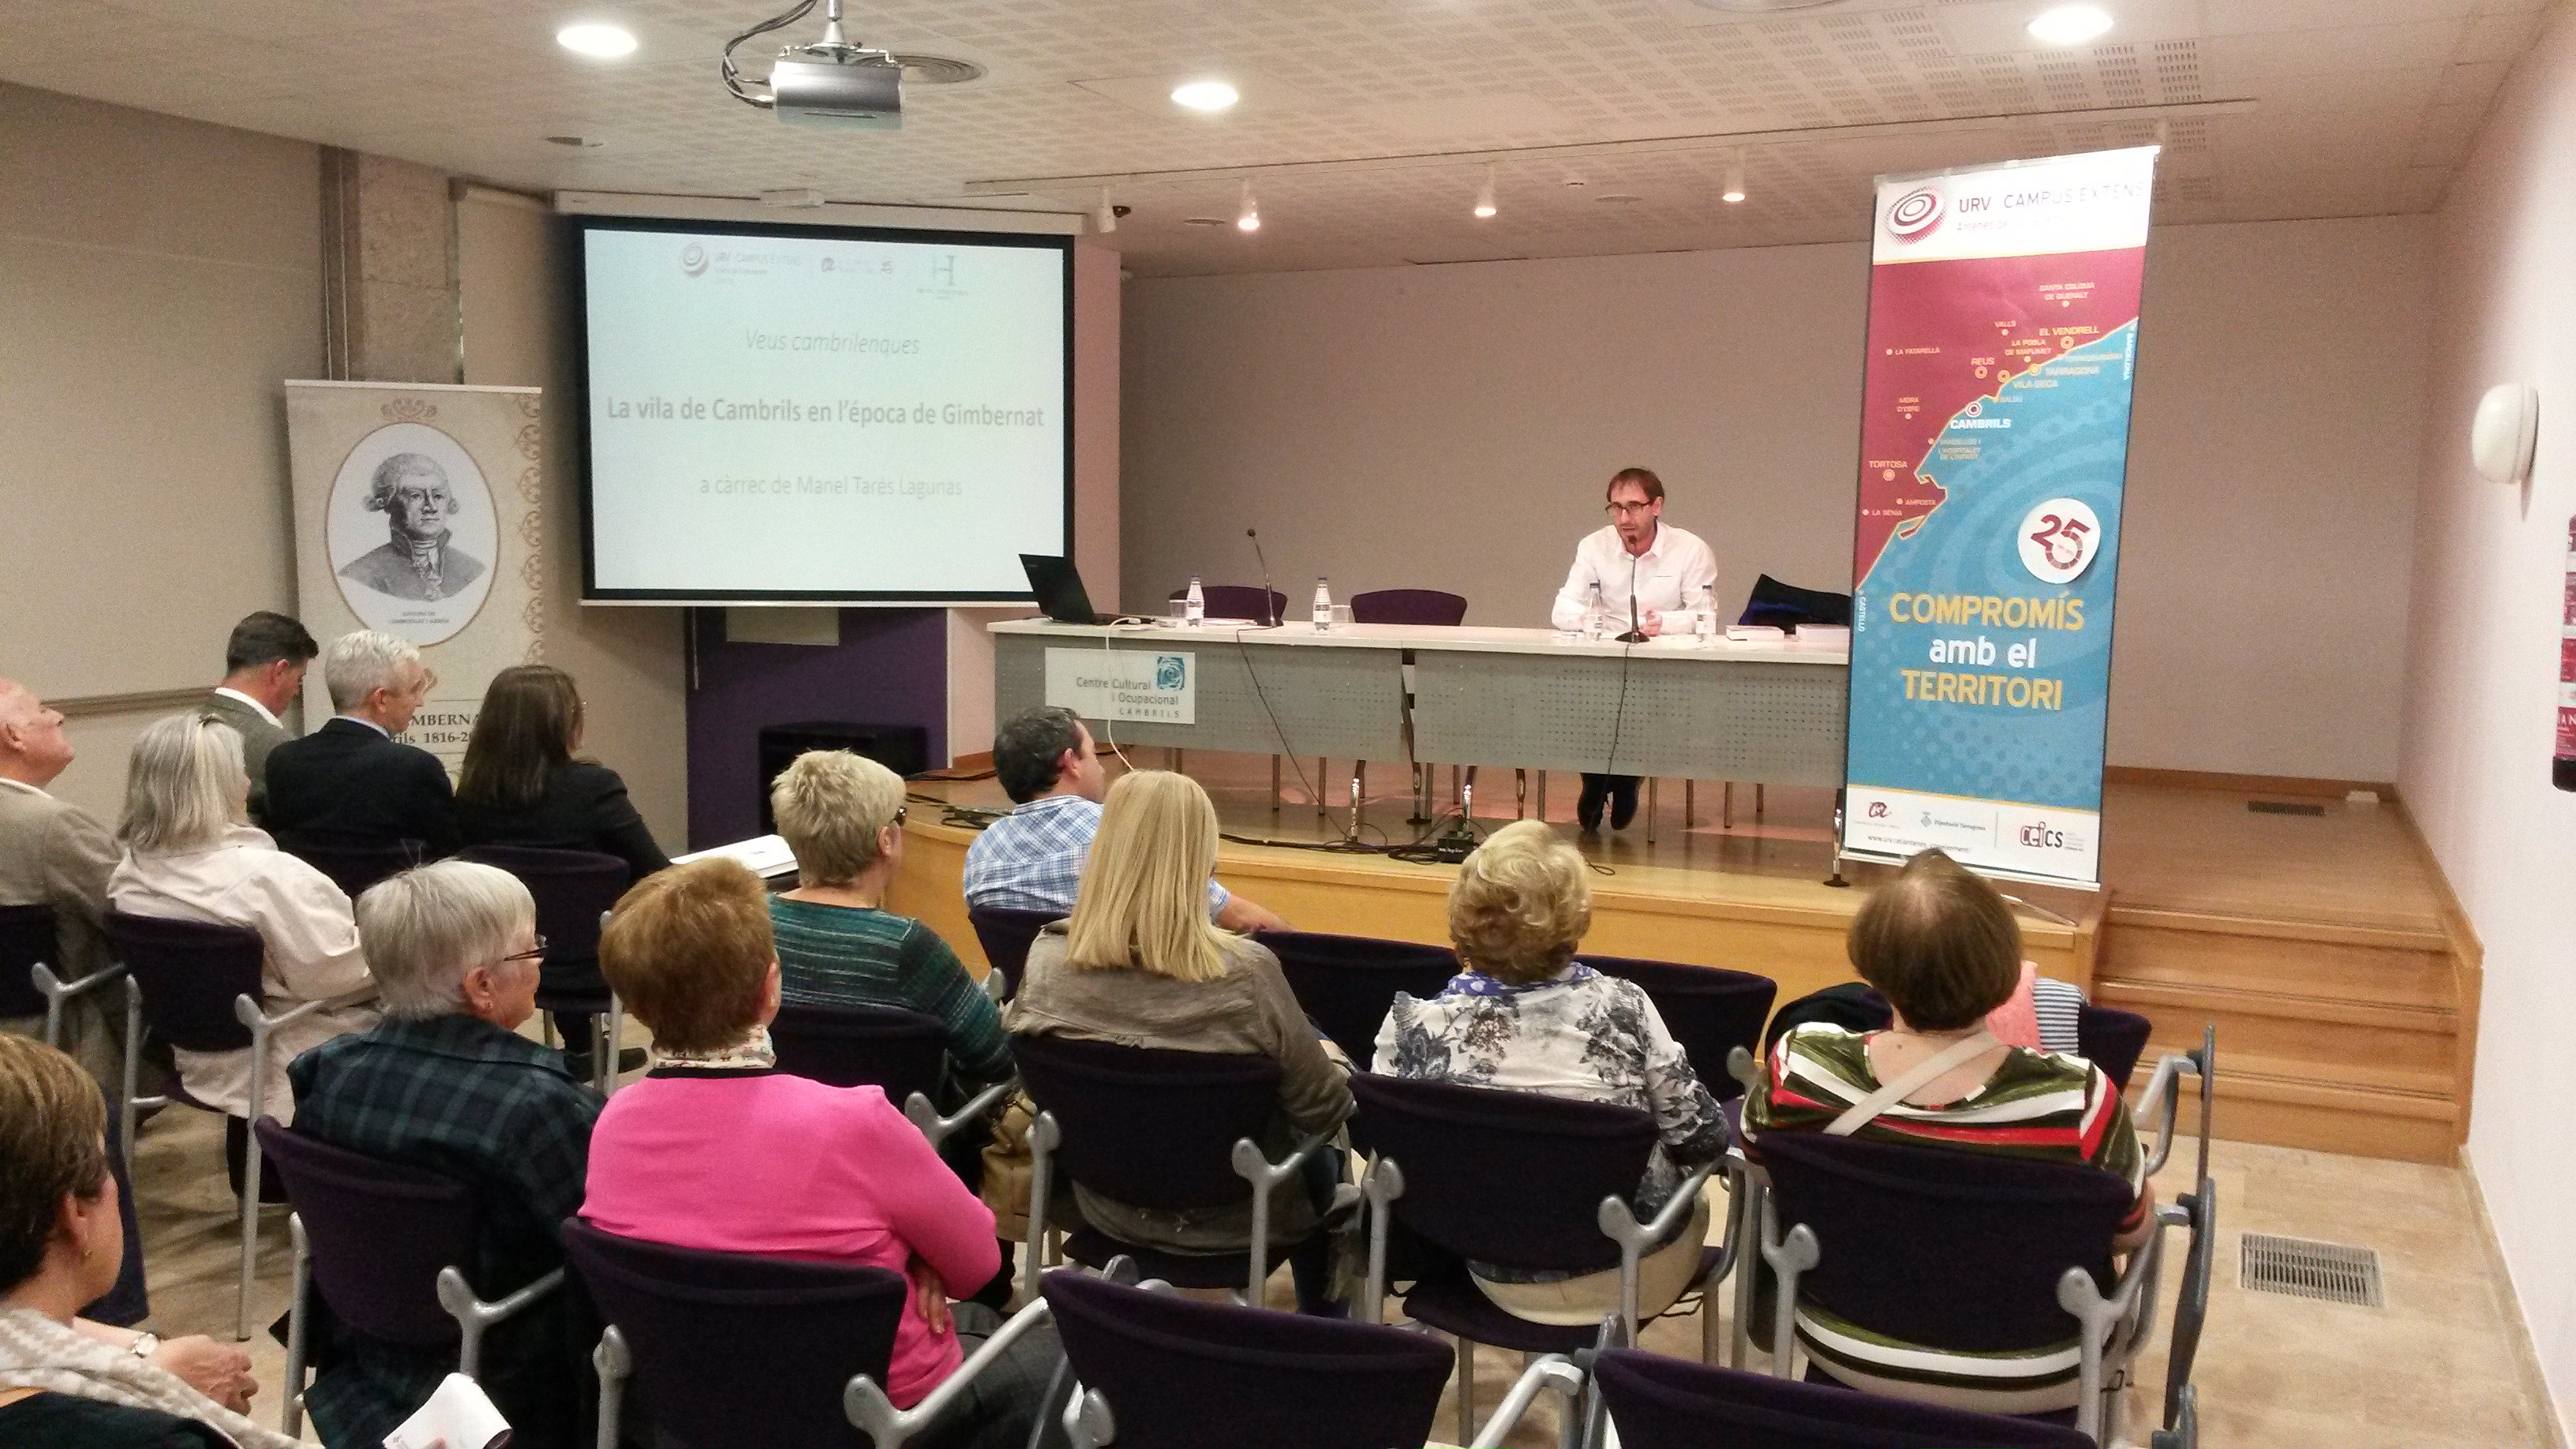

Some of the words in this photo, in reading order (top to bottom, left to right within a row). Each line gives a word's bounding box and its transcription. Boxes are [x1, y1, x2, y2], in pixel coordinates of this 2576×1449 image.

[1958, 196, 1992, 213] URV
[2003, 189, 2073, 209] CAMPUS
[2039, 328, 2051, 337] EL
[745, 328, 787, 350] Veus
[791, 331, 921, 358] cambrilenques
[1971, 357, 1996, 366] REUS
[607, 396, 631, 418] La
[636, 396, 674, 419] vila
[680, 397, 706, 420] de
[712, 398, 802, 421] Cambrils
[807, 404, 832, 422] en
[912, 402, 937, 425] de
[942, 403, 1045, 427] Gimbernat
[1949, 418, 2012, 429] CAMBRILS
[1868, 459, 1908, 469] TORTOSA
[700, 479, 710, 495] a
[771, 477, 792, 495] de
[796, 476, 848, 495] Manel
[898, 477, 964, 500] Lagunas
[2031, 513, 2091, 570] 25
[1889, 591, 2084, 631] COMPROMÍS
[1929, 635, 1997, 666] amb
[2007, 638, 2037, 668] el
[1076, 676, 1109, 688] Centre
[1112, 679, 1151, 691] Cultural
[1900, 669, 2064, 711] TERRITORI
[1118, 692, 1179, 706] Ocupacional
[412, 713, 479, 726] MBERN
[1119, 708, 1180, 718] CAMBRILS
[392, 732, 416, 743] rils
[424, 731, 474, 743] 1816-2
